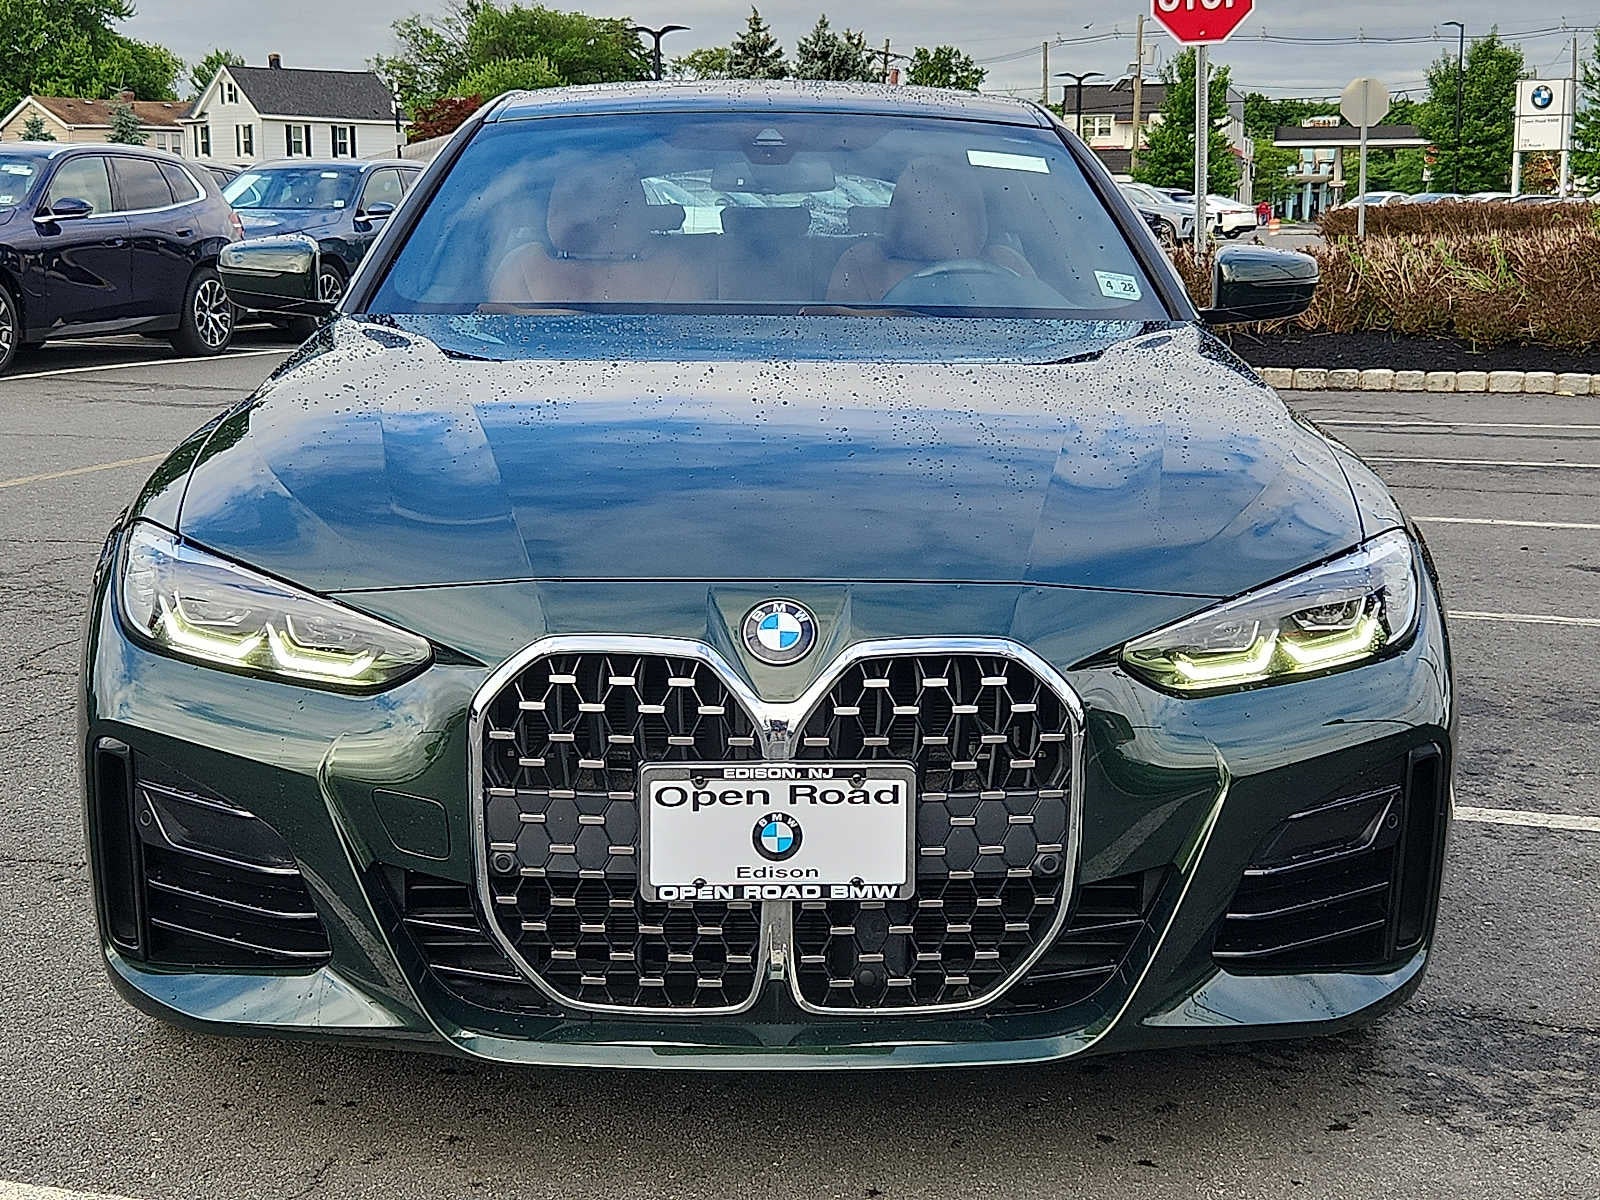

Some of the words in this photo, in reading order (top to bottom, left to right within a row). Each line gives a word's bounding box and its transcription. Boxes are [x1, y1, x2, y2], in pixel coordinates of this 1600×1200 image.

[1106, 280, 1113, 290] 4
[1121, 282, 1136, 292] 28
[751, 603, 809, 623] BMW
[723, 768, 802, 780] EDISON,
[808, 768, 834, 779] NJ
[655, 786, 770, 812] Open
[789, 784, 899, 805] Road
[758, 813, 798, 828] BMW
[736, 866, 819, 879] Edison
[659, 885, 733, 900] OPEN
[746, 885, 820, 900] ROAD
[831, 885, 897, 899] BMW
